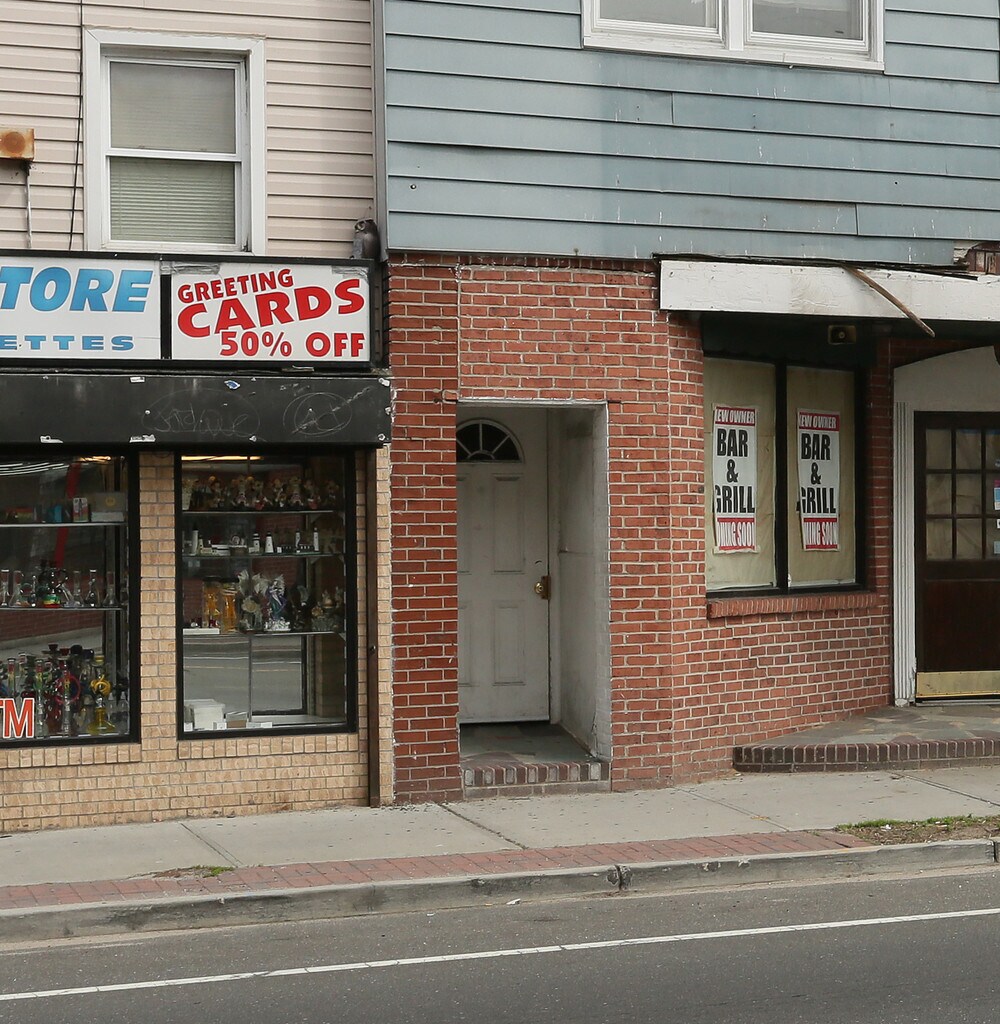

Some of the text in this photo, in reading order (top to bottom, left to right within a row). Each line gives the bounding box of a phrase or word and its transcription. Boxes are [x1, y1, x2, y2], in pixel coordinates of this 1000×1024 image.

[0, 266, 153, 312] TORE
[177, 268, 294, 303] GREETING
[177, 278, 365, 338] CARDS
[0, 335, 134, 351] ETTES
[220, 331, 366, 357] 50% OFF
[730, 410, 755, 424] OWNER
[717, 428, 748, 457] BAR
[801, 433, 831, 460] BAR
[726, 459, 739, 483] &
[810, 462, 822, 485] &
[0, 698, 35, 738] M
